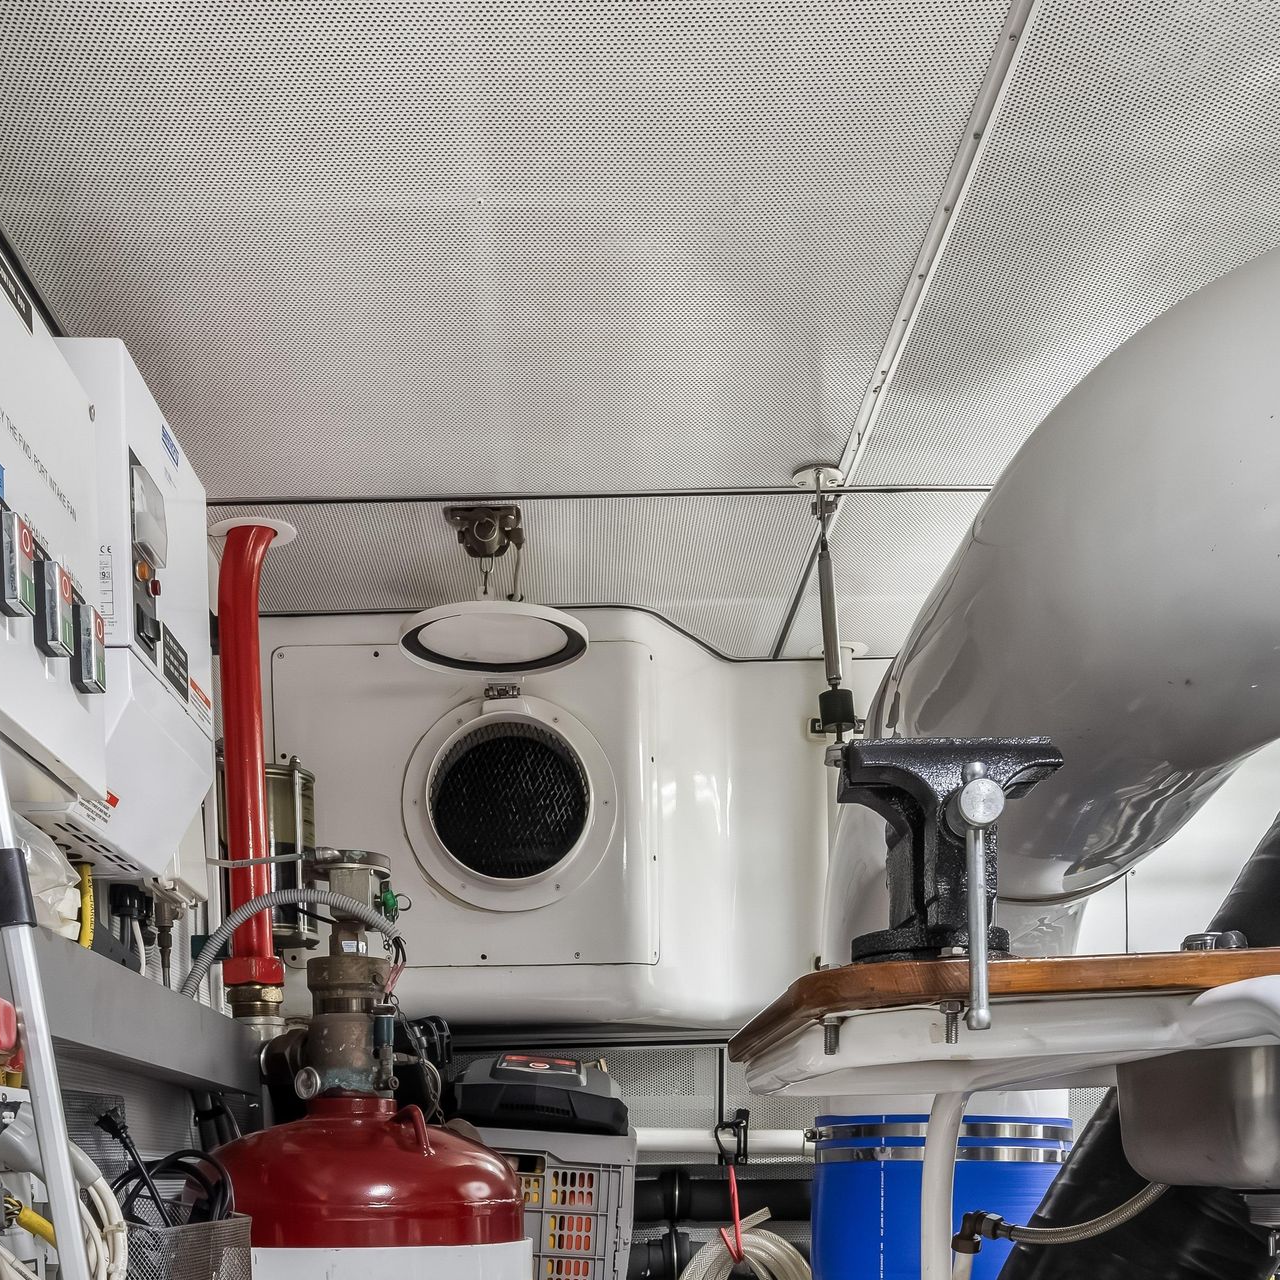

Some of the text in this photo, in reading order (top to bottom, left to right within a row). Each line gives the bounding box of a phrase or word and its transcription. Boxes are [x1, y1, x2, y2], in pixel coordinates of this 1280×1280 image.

[5, 415, 18, 441] THE
[33, 454, 49, 482] PORT
[48, 475, 67, 508] INTAKE
[66, 500, 77, 522] FAN
